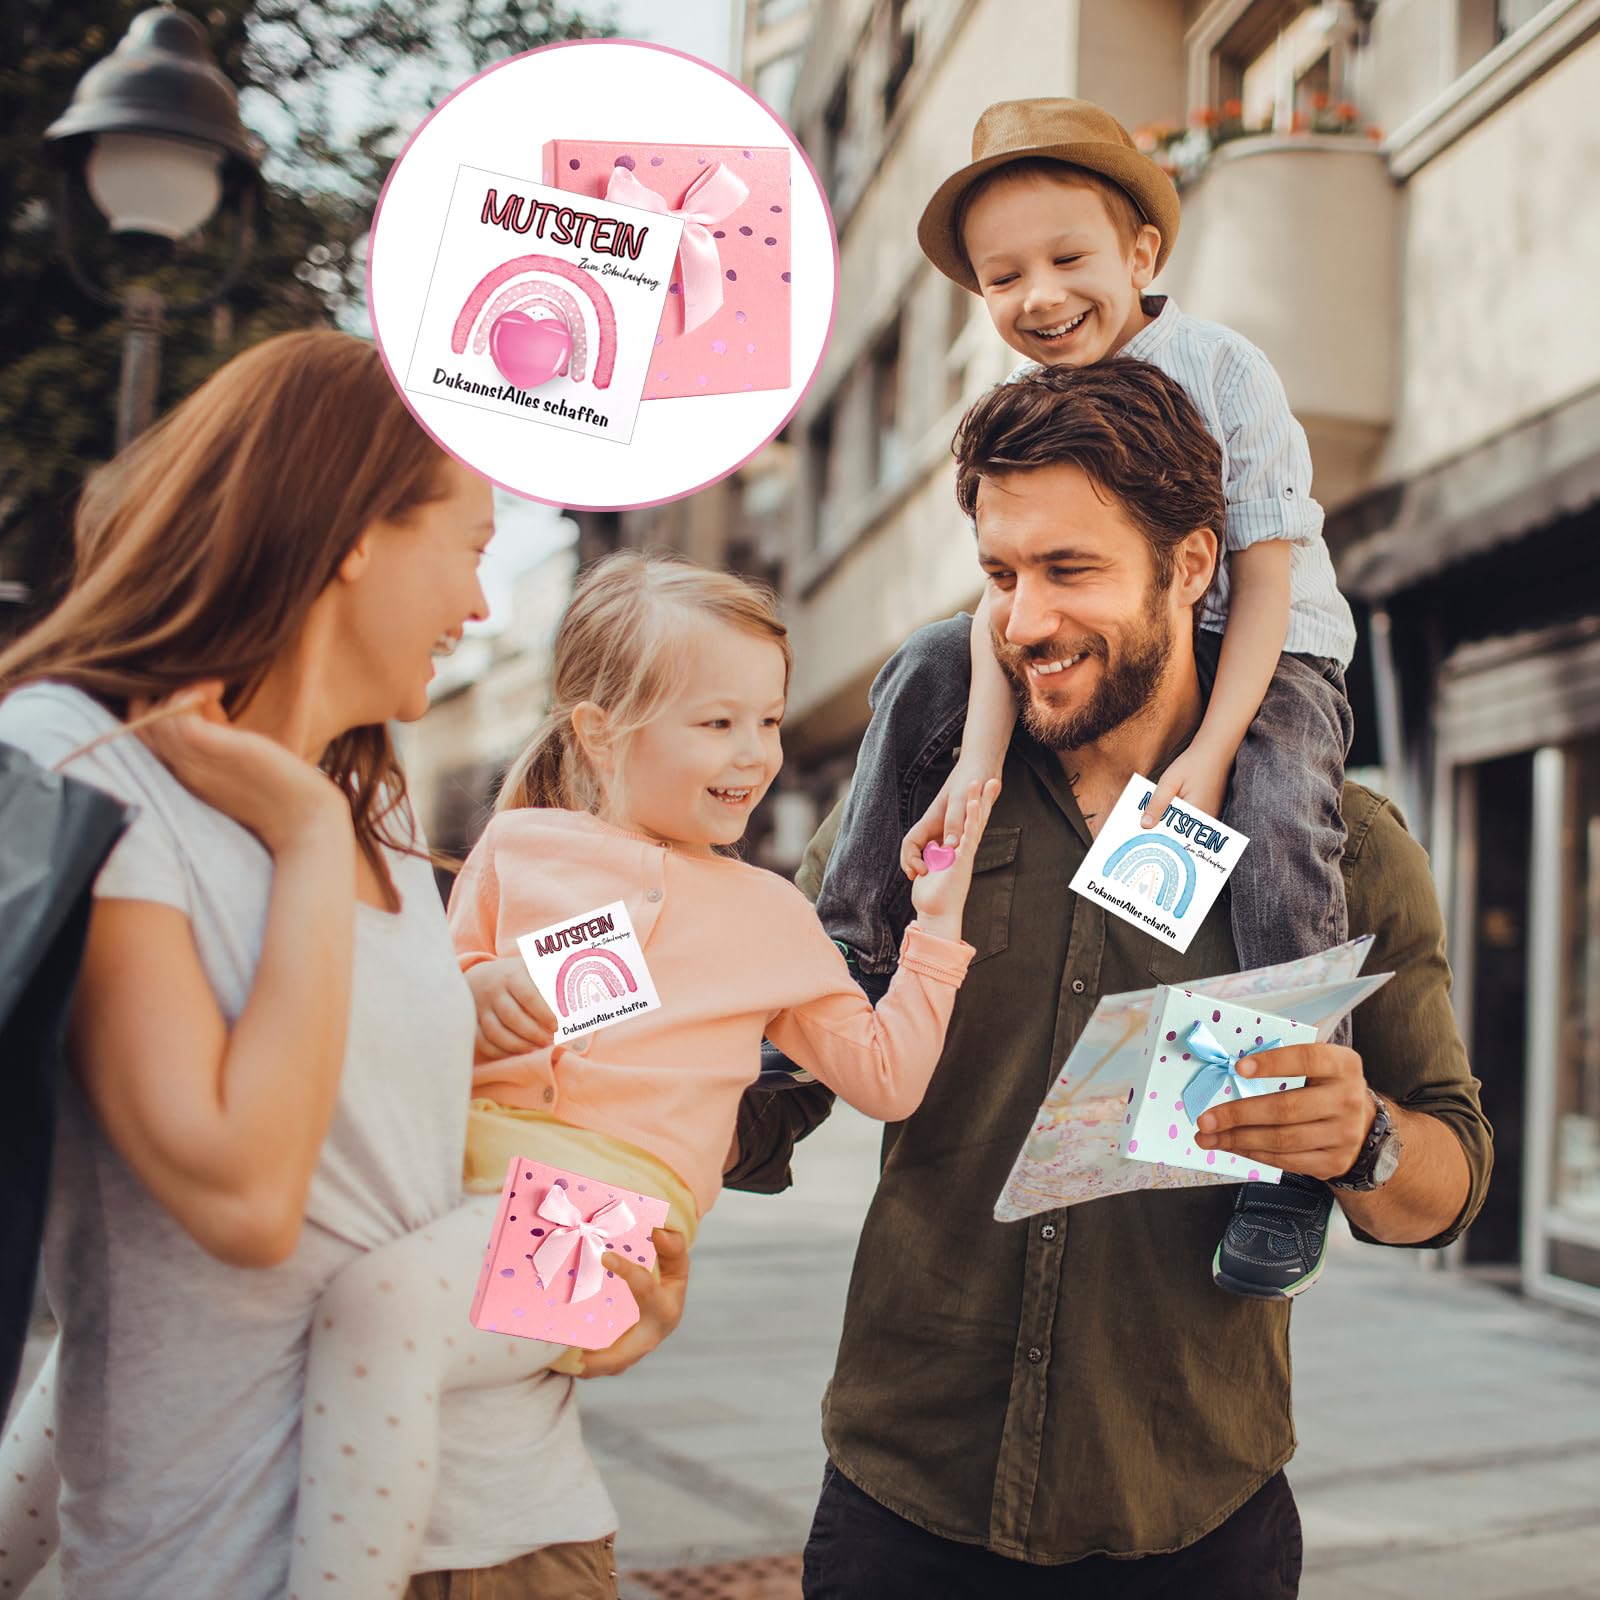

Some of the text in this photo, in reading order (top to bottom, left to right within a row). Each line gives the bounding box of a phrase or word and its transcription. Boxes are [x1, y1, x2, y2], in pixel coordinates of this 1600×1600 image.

[481, 188, 648, 260] MUTSTEIN
[577, 257, 661, 291] Zum Schulanfang
[543, 399, 609, 428] schaffen
[534, 913, 615, 957] MUTSTEIN
[1142, 913, 1177, 940] schaffen
[615, 1000, 648, 1017] schaffen
